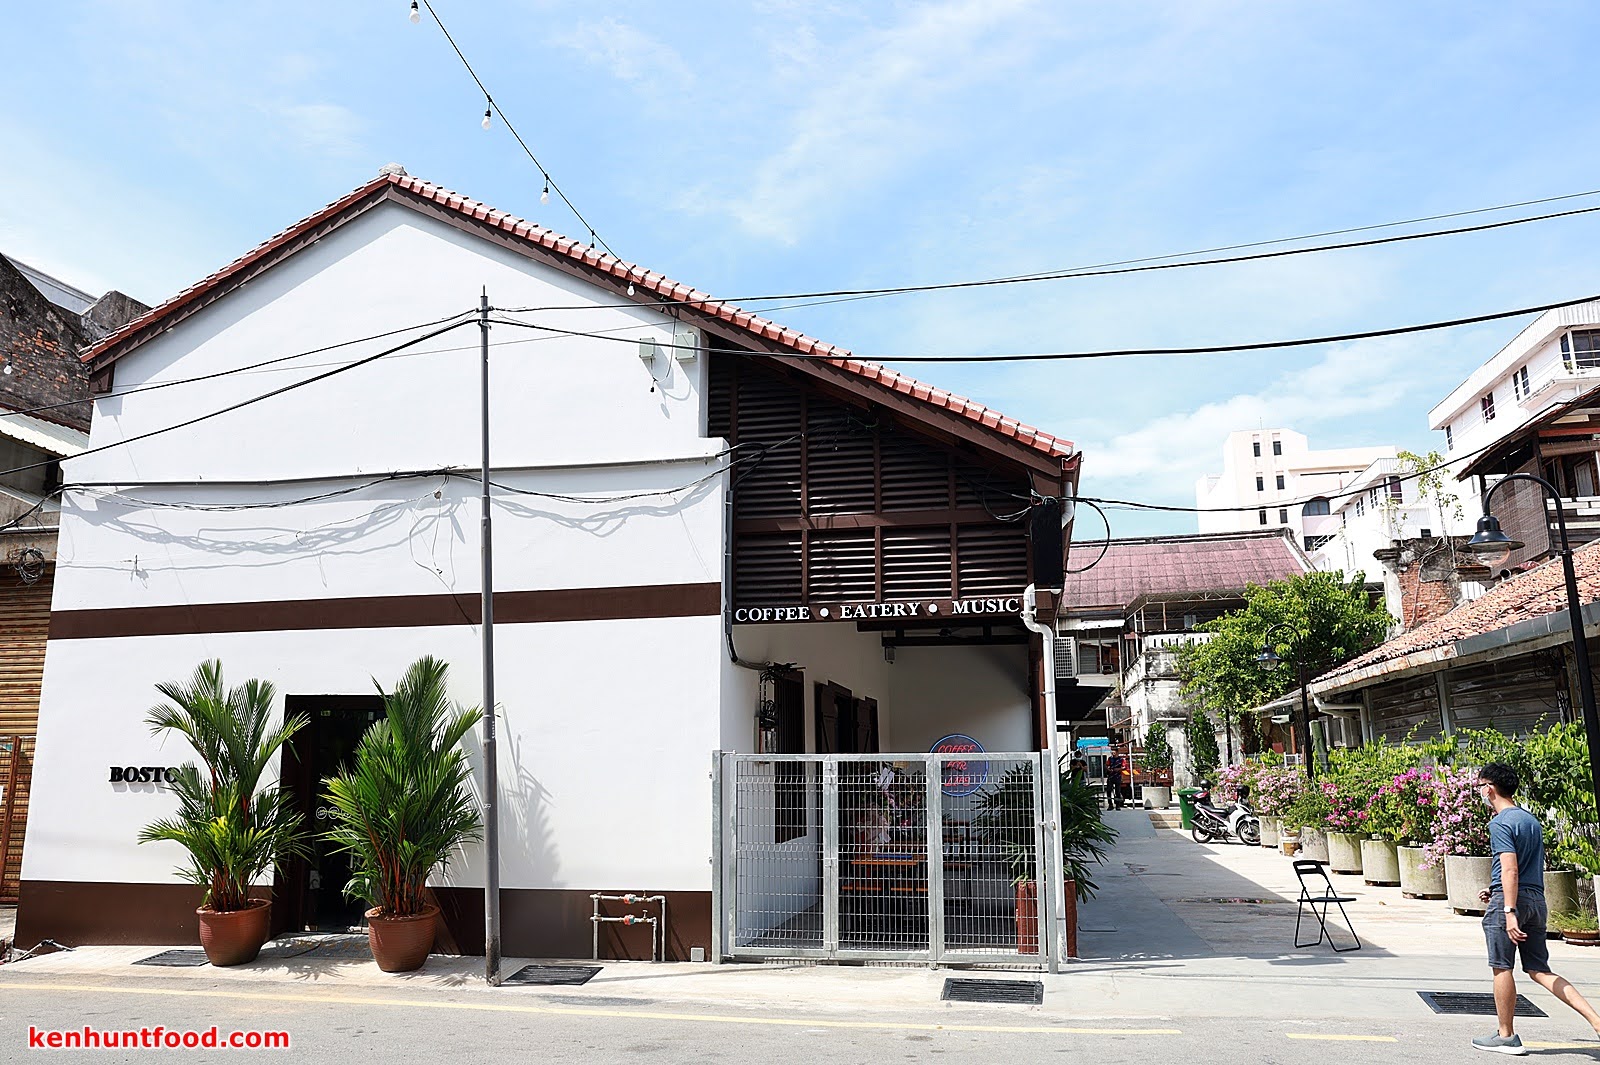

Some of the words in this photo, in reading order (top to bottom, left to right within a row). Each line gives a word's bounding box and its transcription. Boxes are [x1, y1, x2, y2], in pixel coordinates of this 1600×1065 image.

[735, 606, 810, 622] COFFEE
[839, 602, 921, 619] EATERY
[951, 598, 1020, 615] MUSIC
[108, 766, 198, 783] BOSTO
